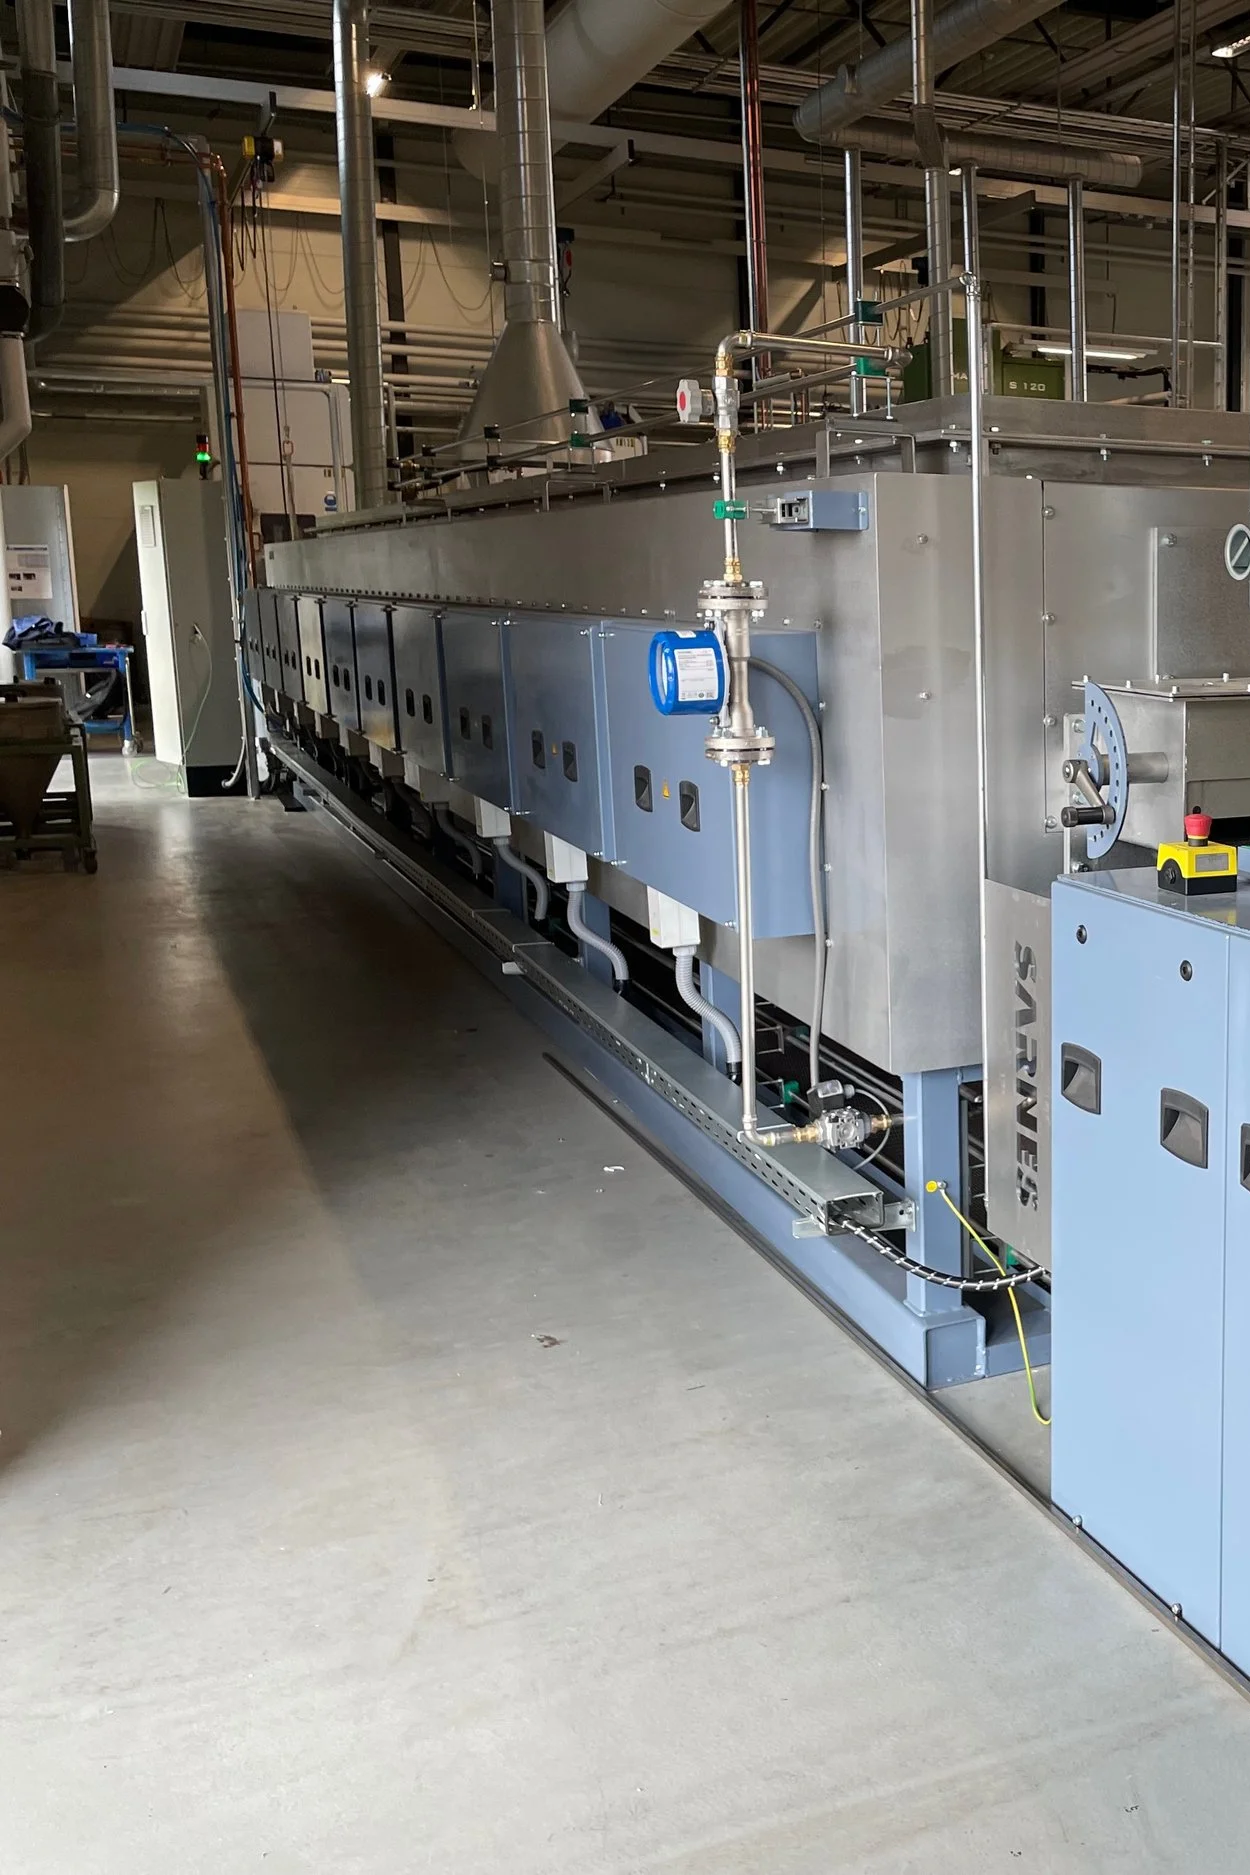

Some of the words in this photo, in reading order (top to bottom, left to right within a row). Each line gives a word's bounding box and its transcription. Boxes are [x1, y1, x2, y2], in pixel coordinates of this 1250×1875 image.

[1009, 381, 1017, 389] S
[1023, 382, 1046, 391] 120
[1015, 941, 1039, 1212] SARNES
